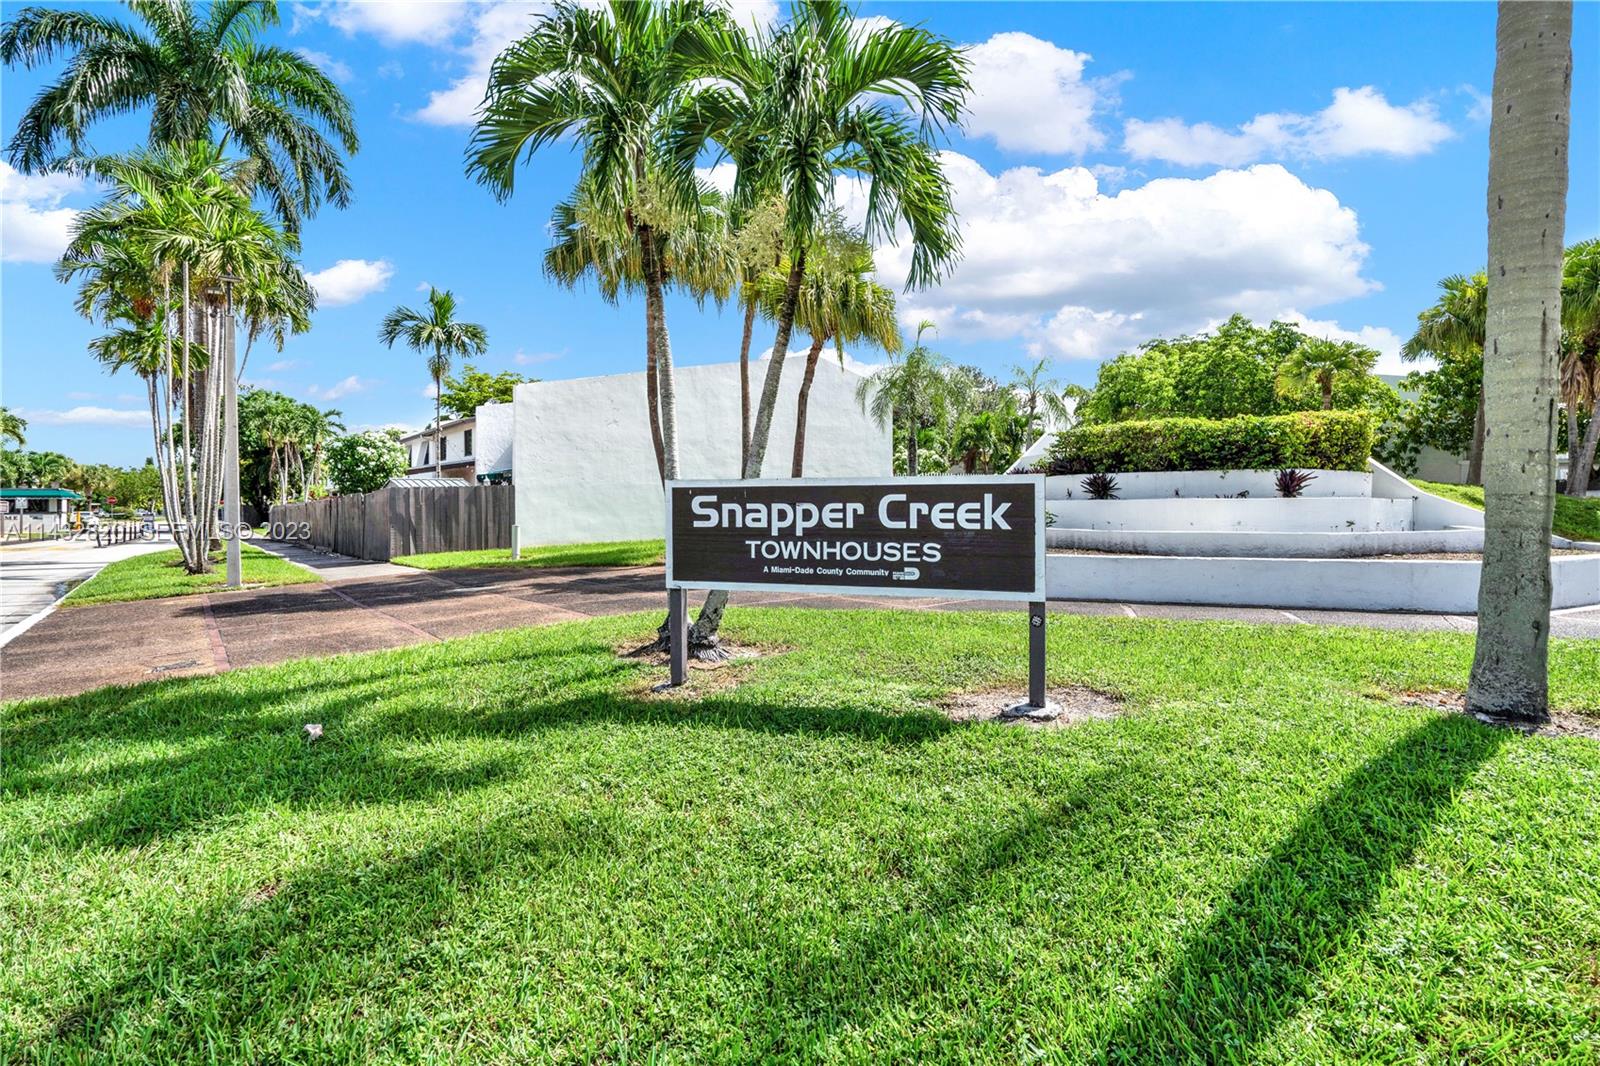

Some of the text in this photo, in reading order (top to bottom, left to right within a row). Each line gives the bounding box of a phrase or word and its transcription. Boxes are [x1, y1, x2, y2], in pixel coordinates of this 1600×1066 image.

[691, 492, 1013, 537] Snapper Creek
[744, 540, 942, 563] TOWNHOUSES
[763, 565, 769, 573] A
[771, 565, 814, 575] Miami-Dade
[816, 566, 844, 577] County
[846, 567, 890, 577] Community
